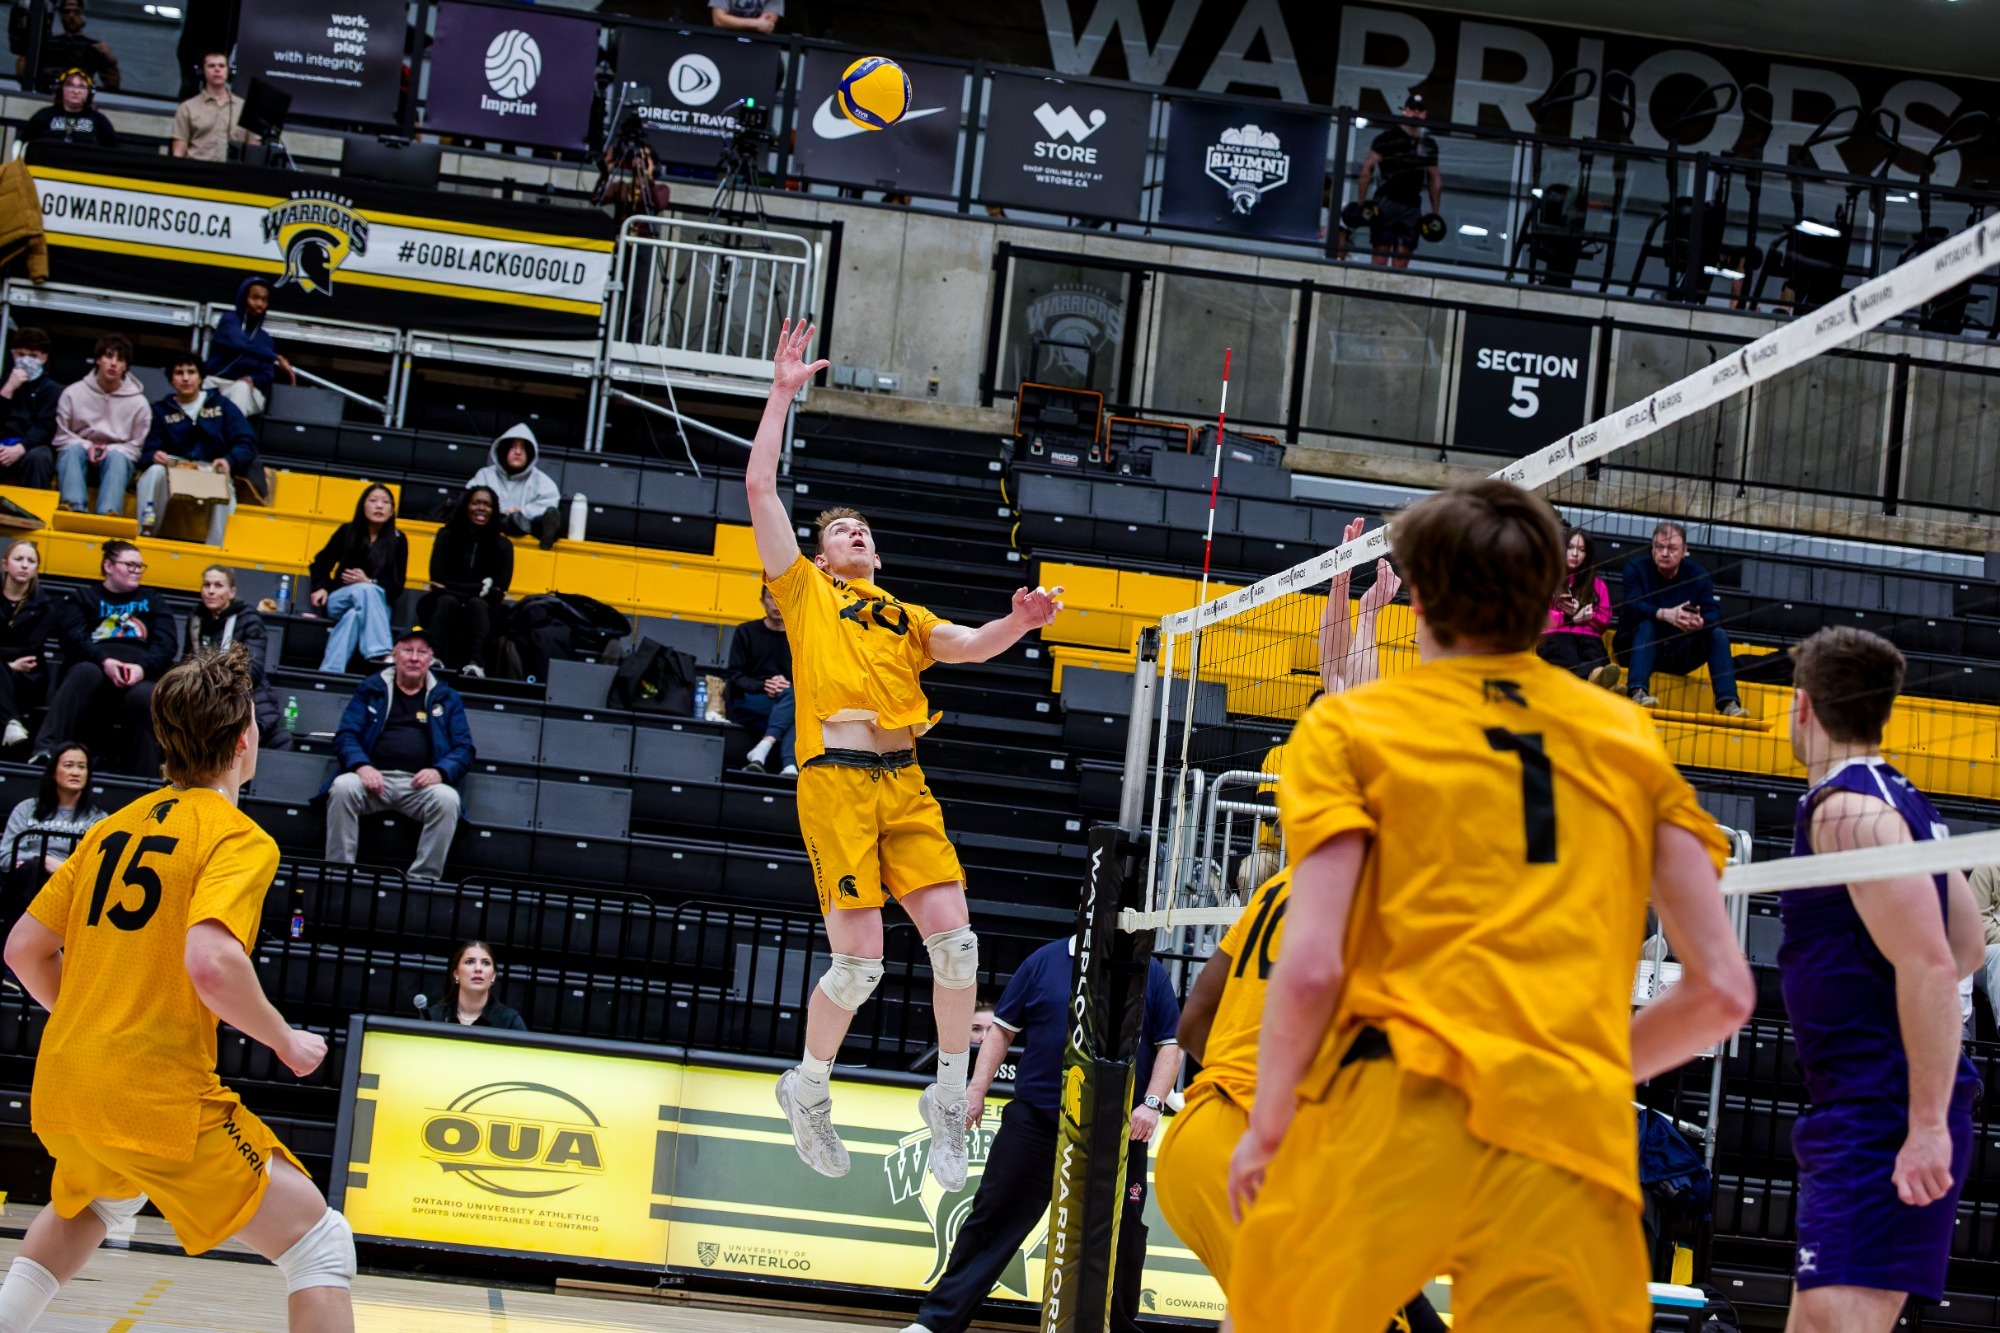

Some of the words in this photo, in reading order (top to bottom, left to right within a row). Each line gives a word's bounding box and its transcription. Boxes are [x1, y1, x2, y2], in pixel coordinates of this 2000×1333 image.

[331, 14, 369, 28] work.
[326, 27, 368, 43] study.
[333, 41, 366, 56] play.
[274, 51, 303, 63] with
[305, 52, 364, 73] integrity.
[481, 94, 538, 116] Imprint
[1043, 0, 1963, 188] WARRIORS
[637, 106, 689, 123] DIRECT
[1034, 141, 1097, 164] STORE
[1216, 144, 1241, 153] BLACK
[1243, 146, 1260, 155] AND
[1210, 152, 1285, 176] ALUMNI
[1229, 167, 1263, 183] PASS
[1036, 174, 1088, 188] WSTORE.CA
[291, 189, 353, 207] WATERLOO
[42, 193, 232, 239] GOWARRIORSGO.CA
[262, 203, 369, 257] WARRIORS
[398, 240, 586, 285] #GOBLACKGOGOLD
[1026, 295, 1123, 345] WARRIORS
[1476, 348, 1578, 379] SECTION
[1508, 376, 1539, 419] 5
[1482, 726, 1558, 863] 1
[86, 831, 180, 931] 15
[1073, 846, 1103, 1051] WATERLOO
[422, 1115, 604, 1170] OUA
[412, 1207, 449, 1217] SPORTS
[452, 1211, 530, 1225] UNIVERSITAIRES
[533, 1219, 546, 1227] DE
[548, 1221, 600, 1232] L'ONTARIO
[413, 1197, 463, 1208] ONTARIO
[467, 1202, 534, 1216] UNIVERSITY
[539, 1210, 600, 1222] ATHLETICS
[723, 1252, 811, 1271] WATERLOO
[729, 1244, 789, 1256] UNIVERSITY
